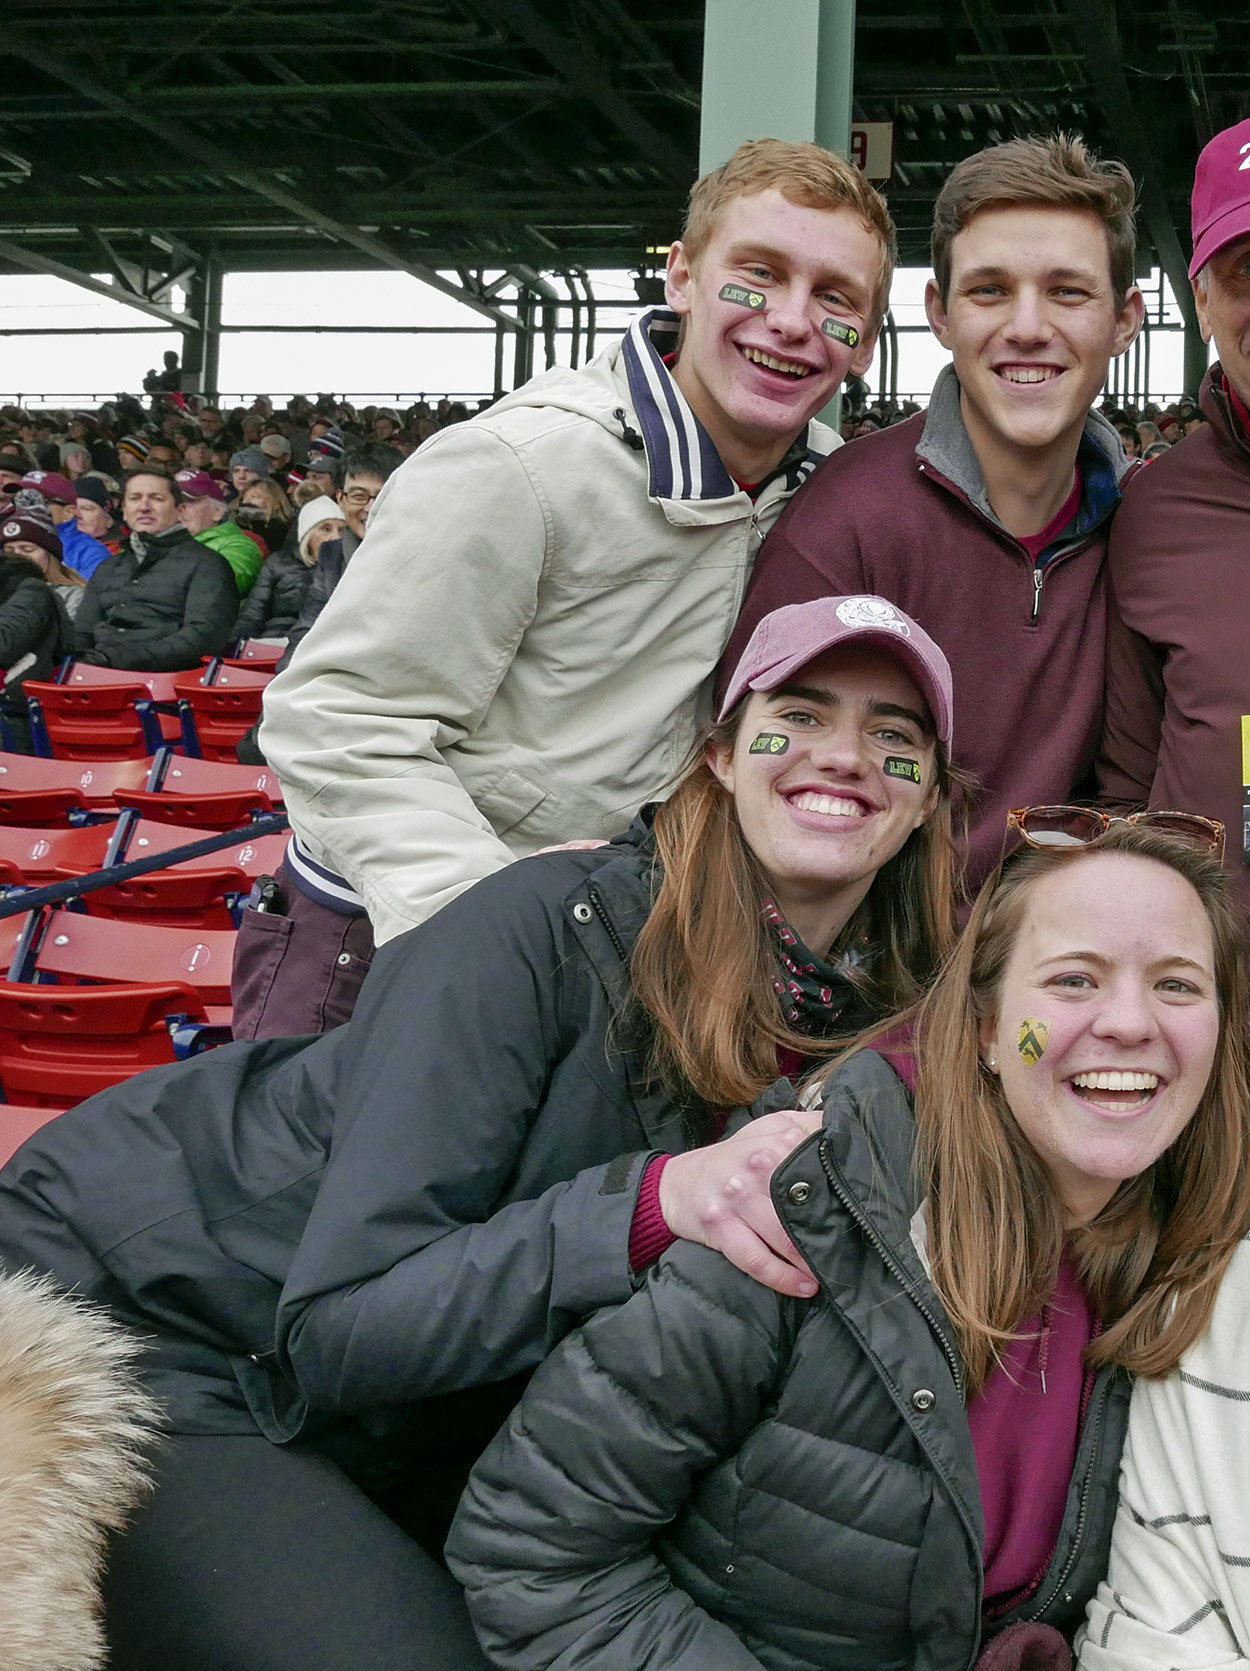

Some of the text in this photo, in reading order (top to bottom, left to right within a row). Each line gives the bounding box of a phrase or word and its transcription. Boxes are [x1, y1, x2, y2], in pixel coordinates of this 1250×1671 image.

[722, 287, 748, 301] LEV
[825, 321, 849, 340] LEV
[751, 737, 771, 751] LEV
[889, 760, 913, 777] LEV
[238, 849, 253, 862] 12
